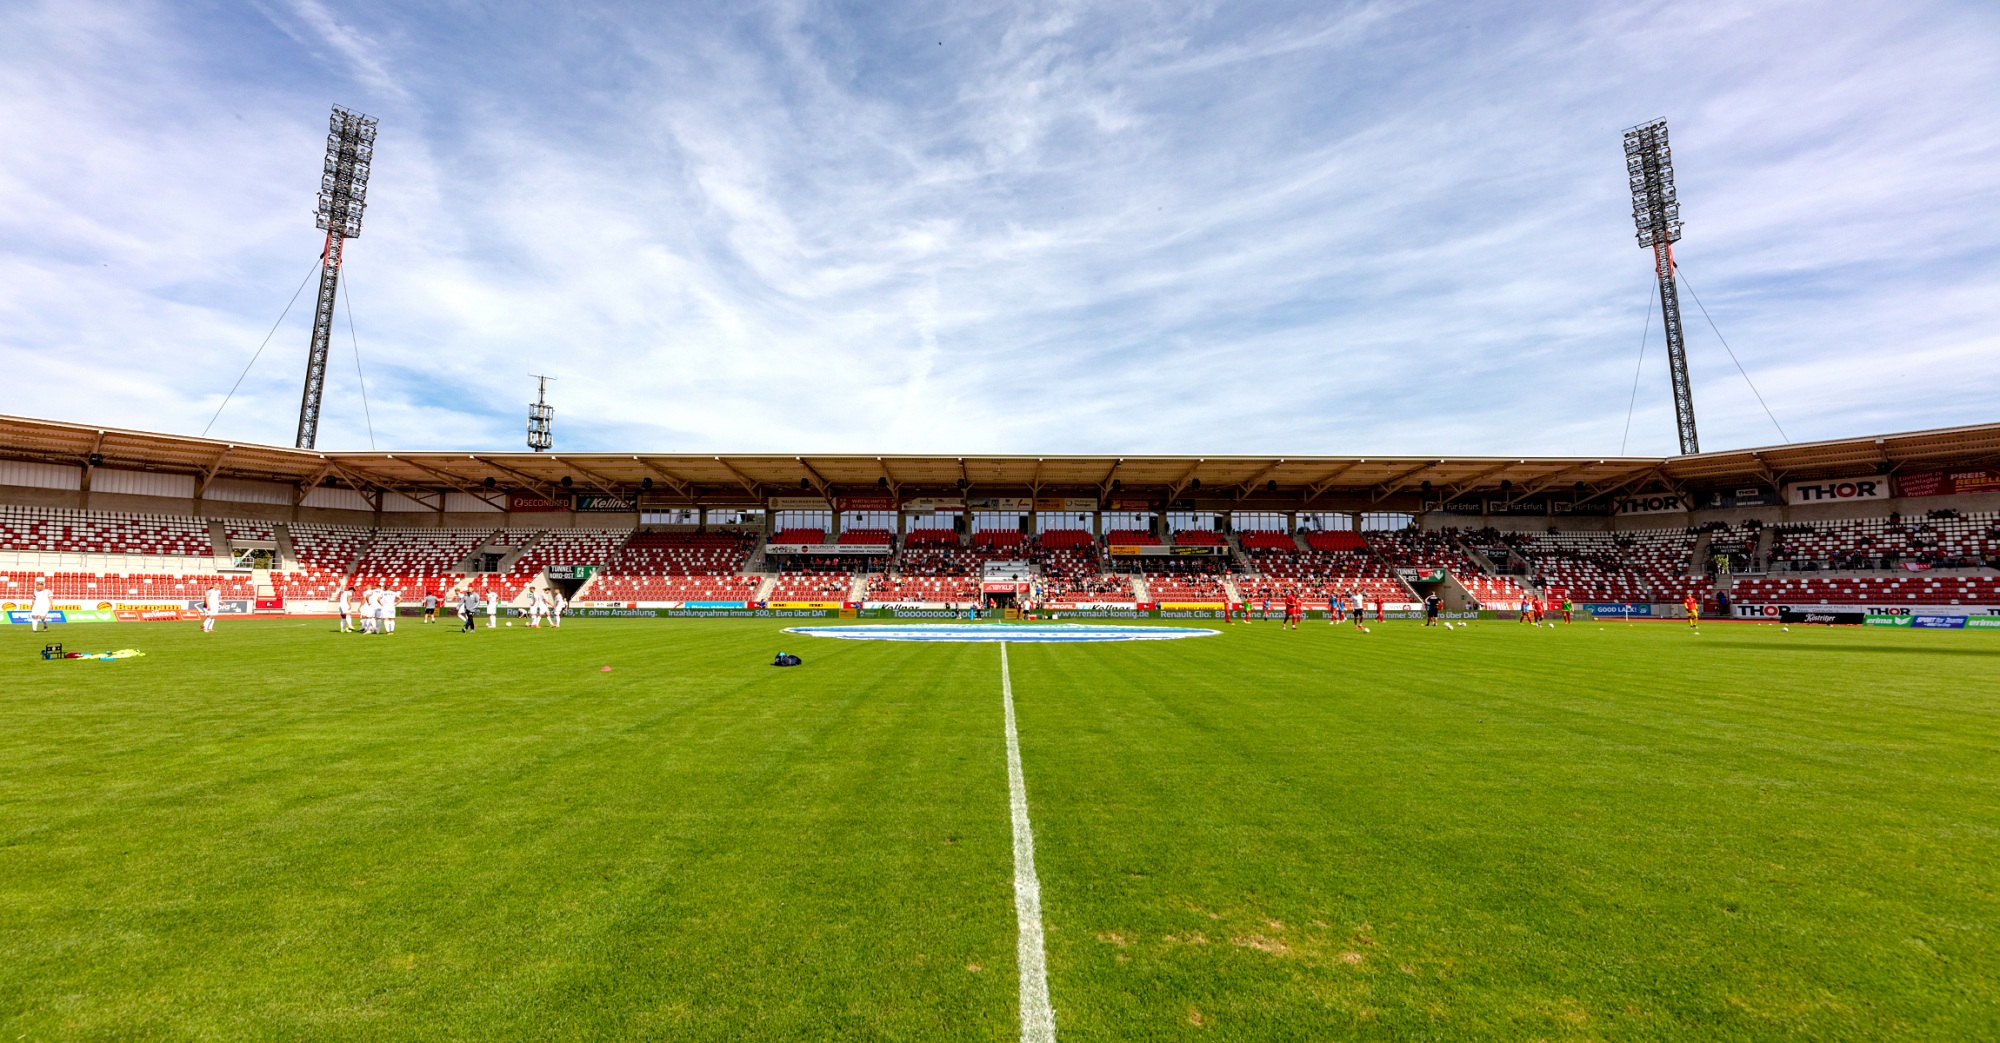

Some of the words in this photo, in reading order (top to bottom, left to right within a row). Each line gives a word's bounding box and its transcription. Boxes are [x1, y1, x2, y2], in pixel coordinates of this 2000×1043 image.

[1949, 471, 1987, 480] PREIS
[1797, 481, 1877, 500] THOR
[590, 498, 636, 509] Kellner
[1447, 502, 1458, 510] Für
[1511, 502, 1522, 510] Für
[1621, 496, 1679, 513] THOR
[115, 603, 181, 611] Bergmann
[1867, 607, 1911, 616] THOR
[611, 609, 658, 618] Anzahlung.
[668, 609, 728, 618] Inzahlungnahme
[730, 609, 754, 617] immer
[755, 609, 774, 618] 500,-
[775, 609, 793, 617] Euro
[794, 609, 811, 617] über
[811, 609, 828, 617] DAT
[1057, 610, 1149, 619] www.renault-koenig.de
[1160, 610, 1192, 618] Renault
[1193, 610, 1212, 618] Clio:
[1231, 610, 1238, 618] €
[1241, 610, 1261, 618] one
[1407, 611, 1426, 620] 500,-
[1446, 611, 1462, 619] über
[1463, 611, 1479, 619] DAT
[1866, 616, 1893, 624] erima
